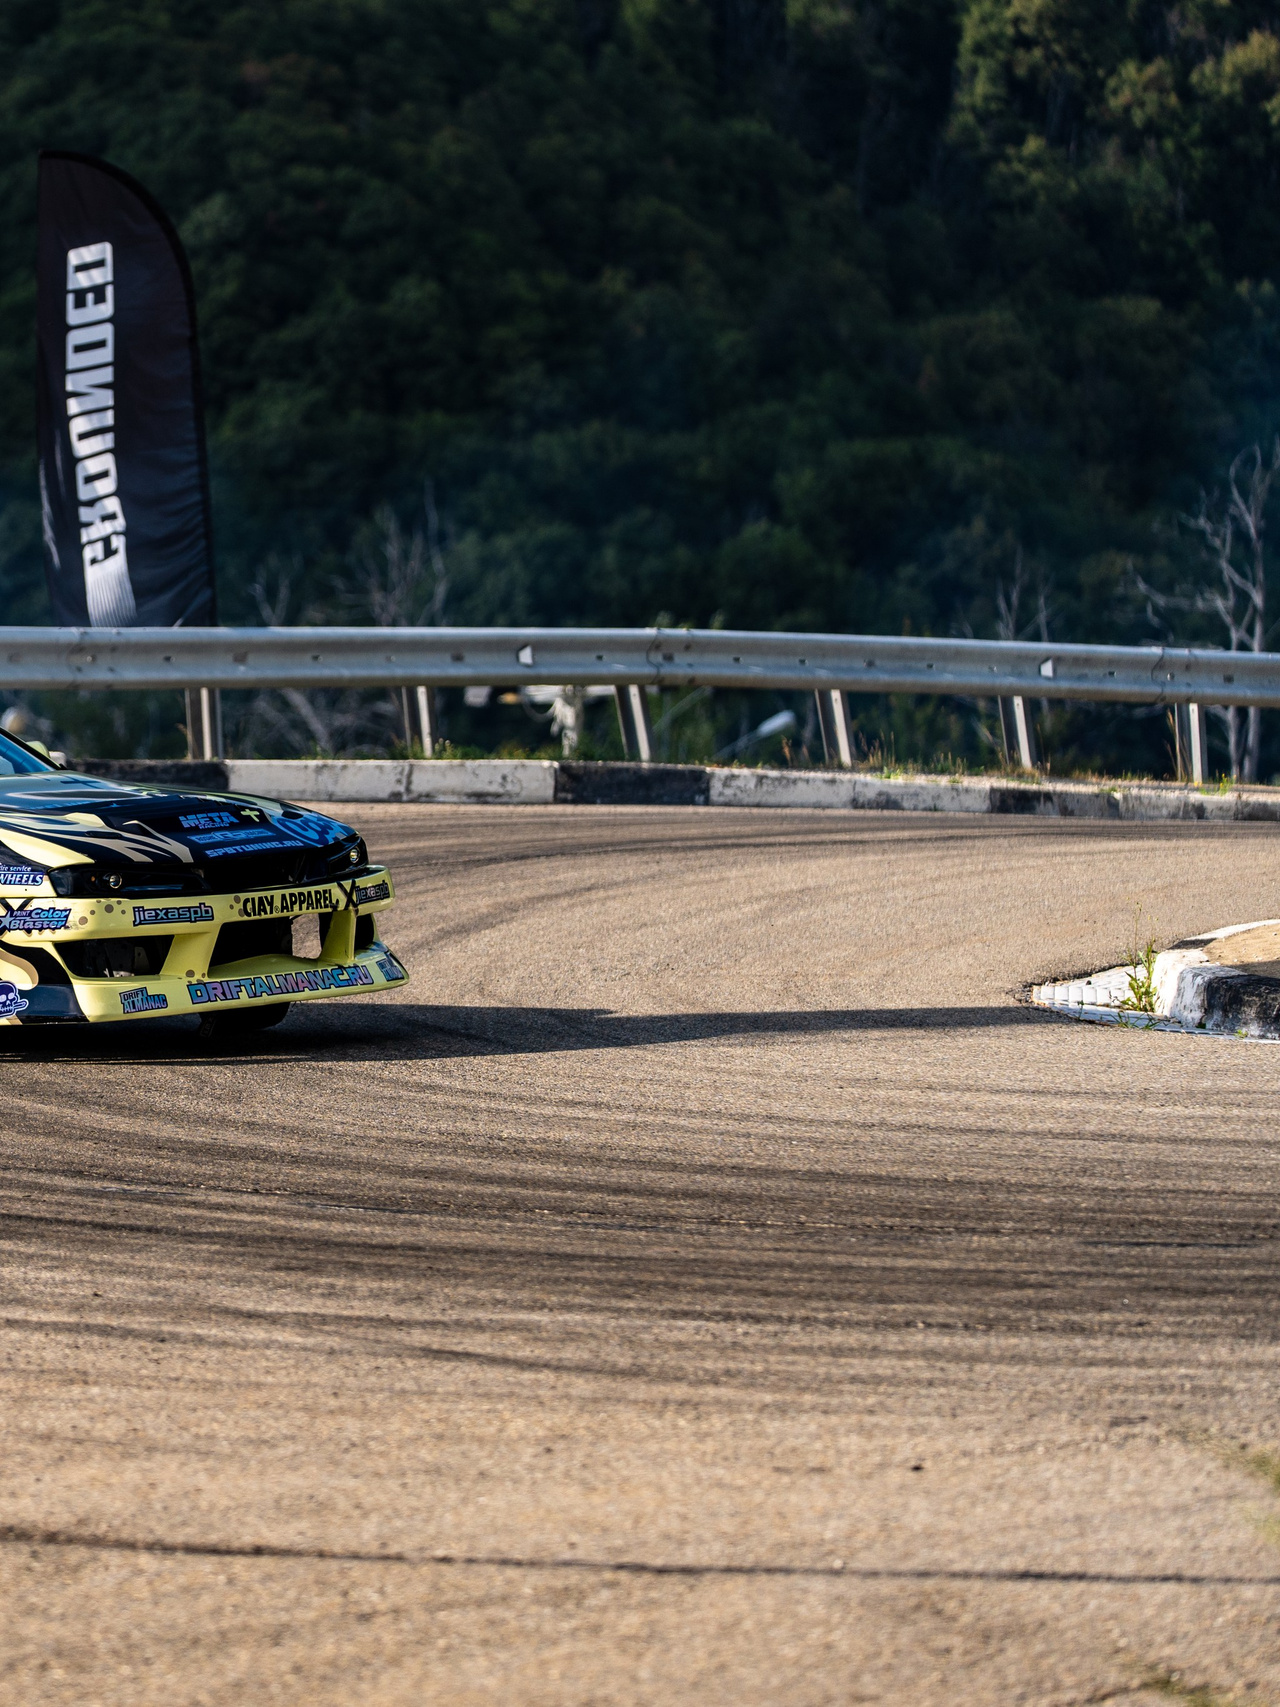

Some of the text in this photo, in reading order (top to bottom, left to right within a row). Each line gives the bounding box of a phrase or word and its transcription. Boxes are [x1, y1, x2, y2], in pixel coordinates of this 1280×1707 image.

[179, 811, 240, 828] META
[205, 839, 304, 858] SPBTUNING.RU
[31, 909, 69, 918] Color
[134, 906, 213, 925] jiexaspb
[10, 920, 66, 929] Blaster
[190, 967, 373, 1003] DRIFTALMANAC.RU
[123, 991, 145, 1001] DRIFT
[123, 995, 167, 1012] ALMANAC
